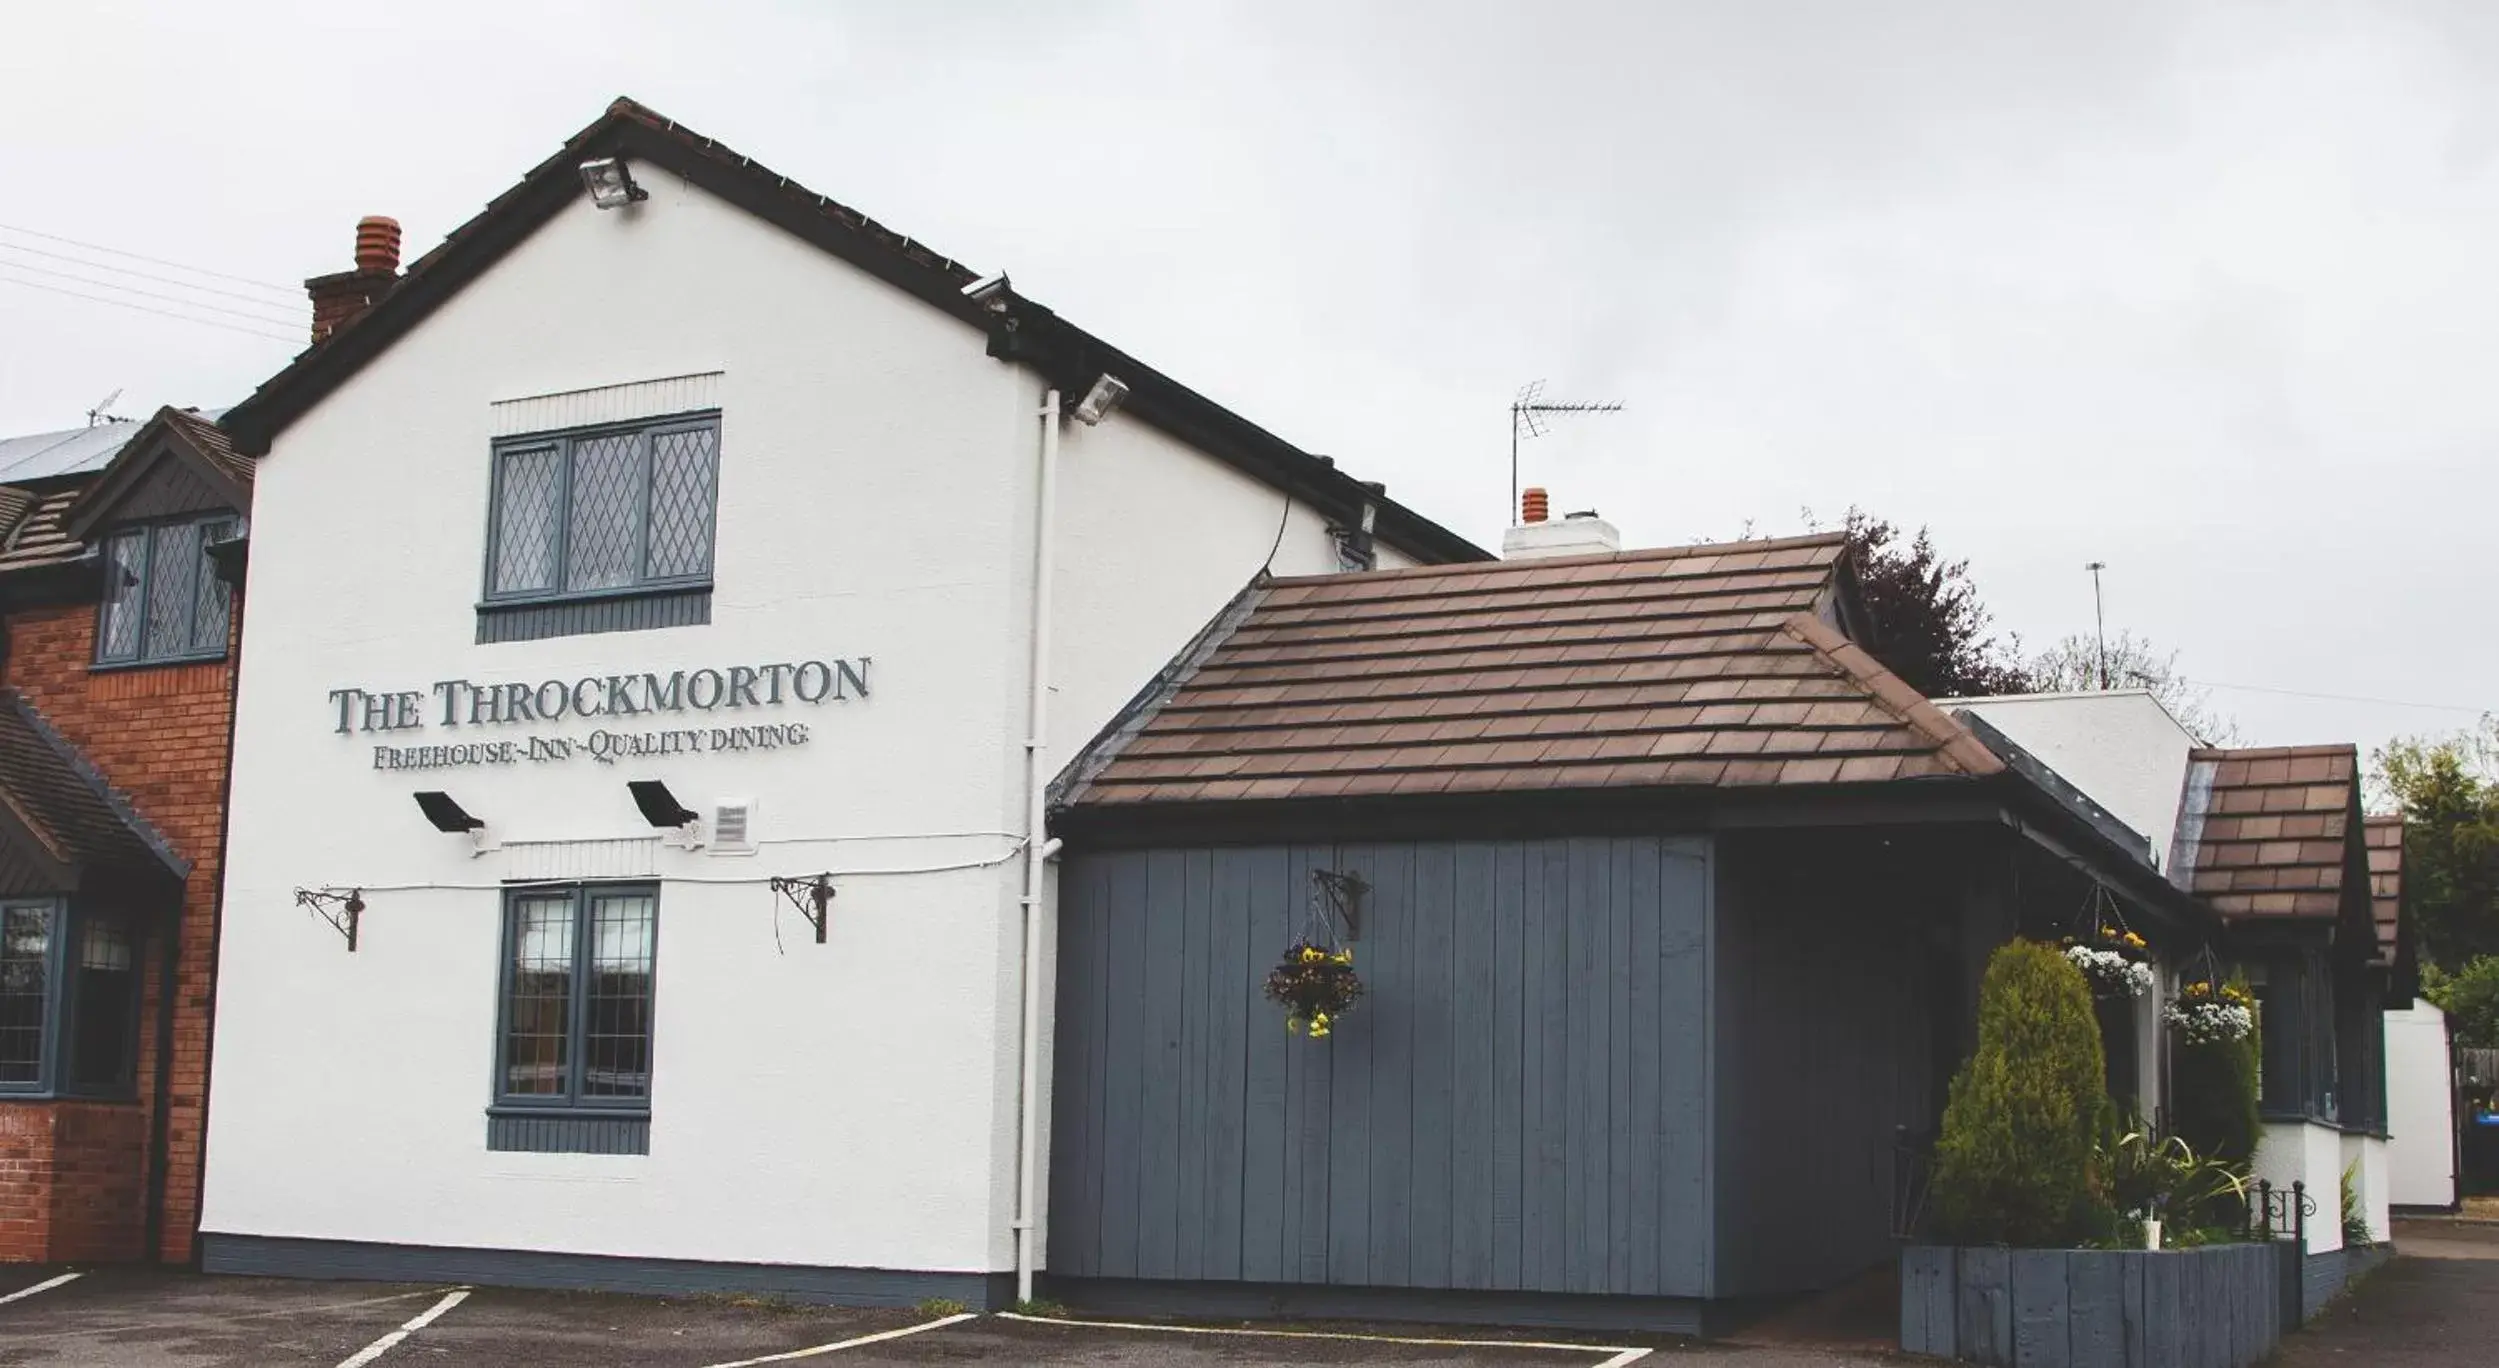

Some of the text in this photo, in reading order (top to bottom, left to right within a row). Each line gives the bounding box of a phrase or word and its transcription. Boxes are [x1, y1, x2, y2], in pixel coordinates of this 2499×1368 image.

[329, 657, 872, 734] THE THROCKMORTON
[710, 723, 810, 751] DINING
